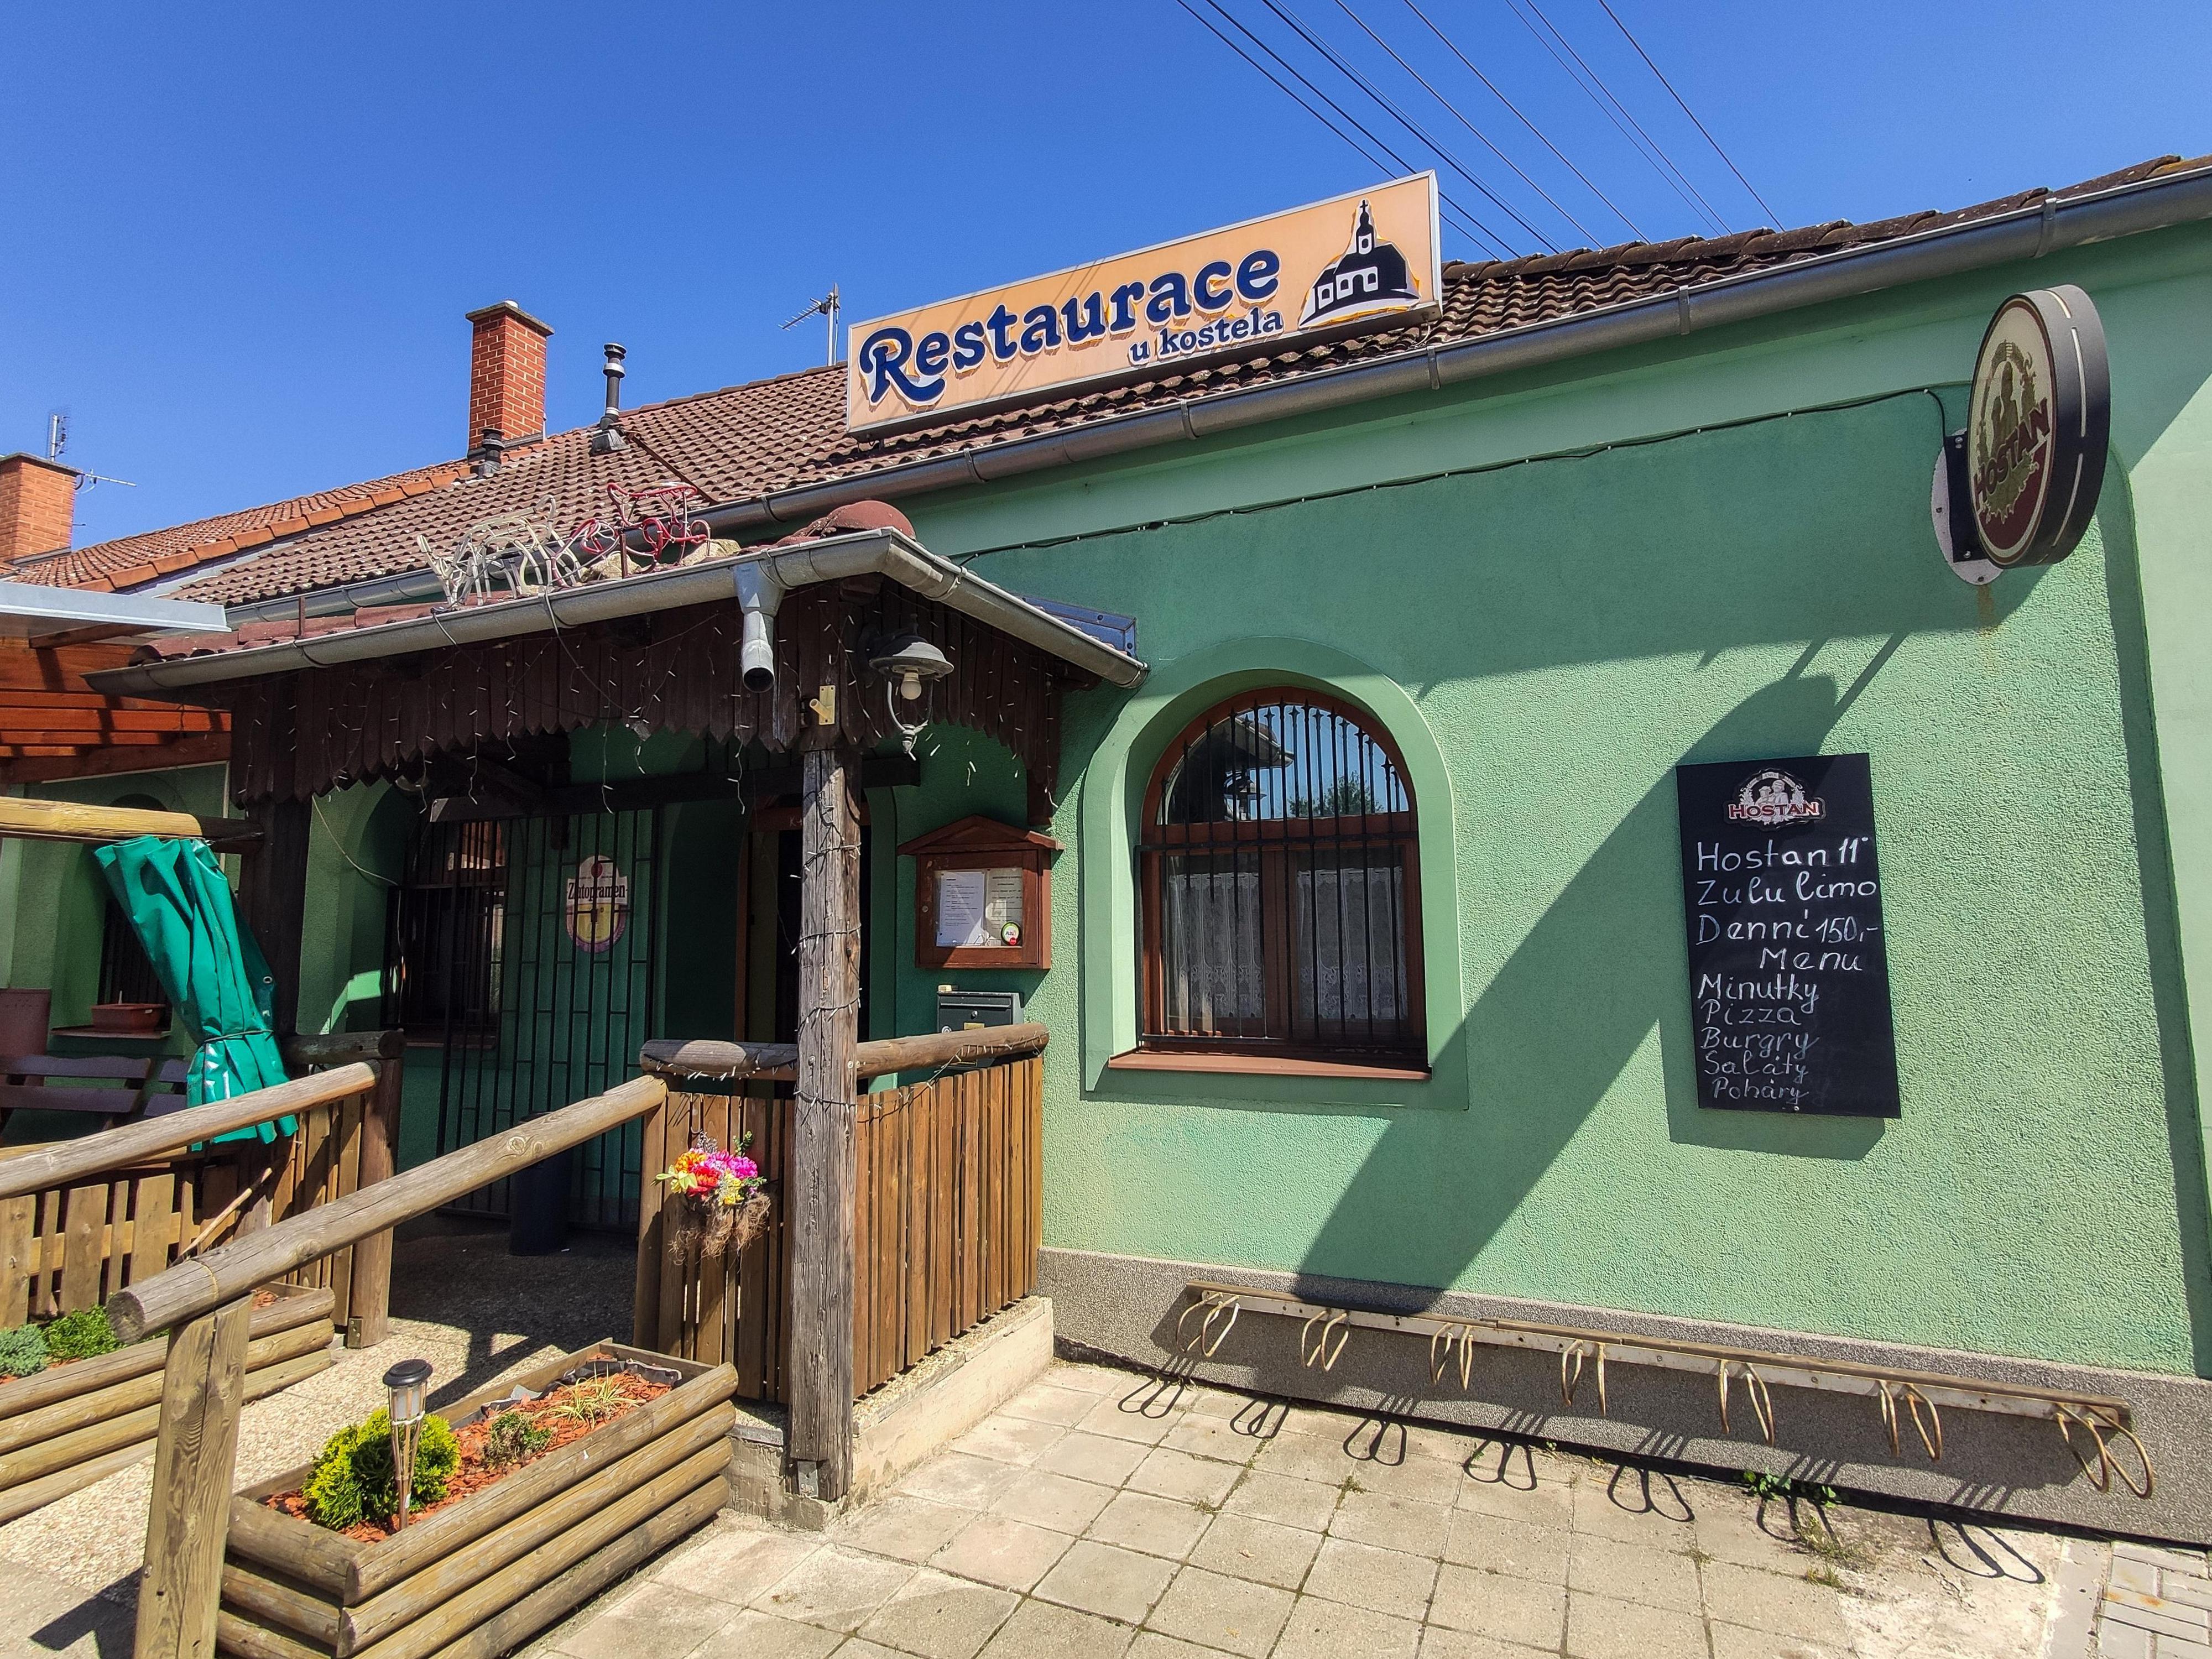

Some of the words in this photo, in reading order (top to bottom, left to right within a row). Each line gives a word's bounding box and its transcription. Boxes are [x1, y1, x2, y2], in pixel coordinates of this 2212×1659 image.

[858, 247, 1281, 405] Restaurace
[1130, 340, 1150, 362] u
[1158, 307, 1284, 357] kostela
[1973, 397, 2050, 513] HOSTAN
[1728, 802, 1820, 820] HOSTAN
[1697, 839, 1827, 872] Hostan
[567, 882, 625, 901] Zatopramen
[1760, 947, 1863, 971] Menu
[1697, 973, 1819, 1014] Minutky
[1700, 998, 1802, 1025] Pizza
[1700, 1026, 1820, 1060] Burgry
